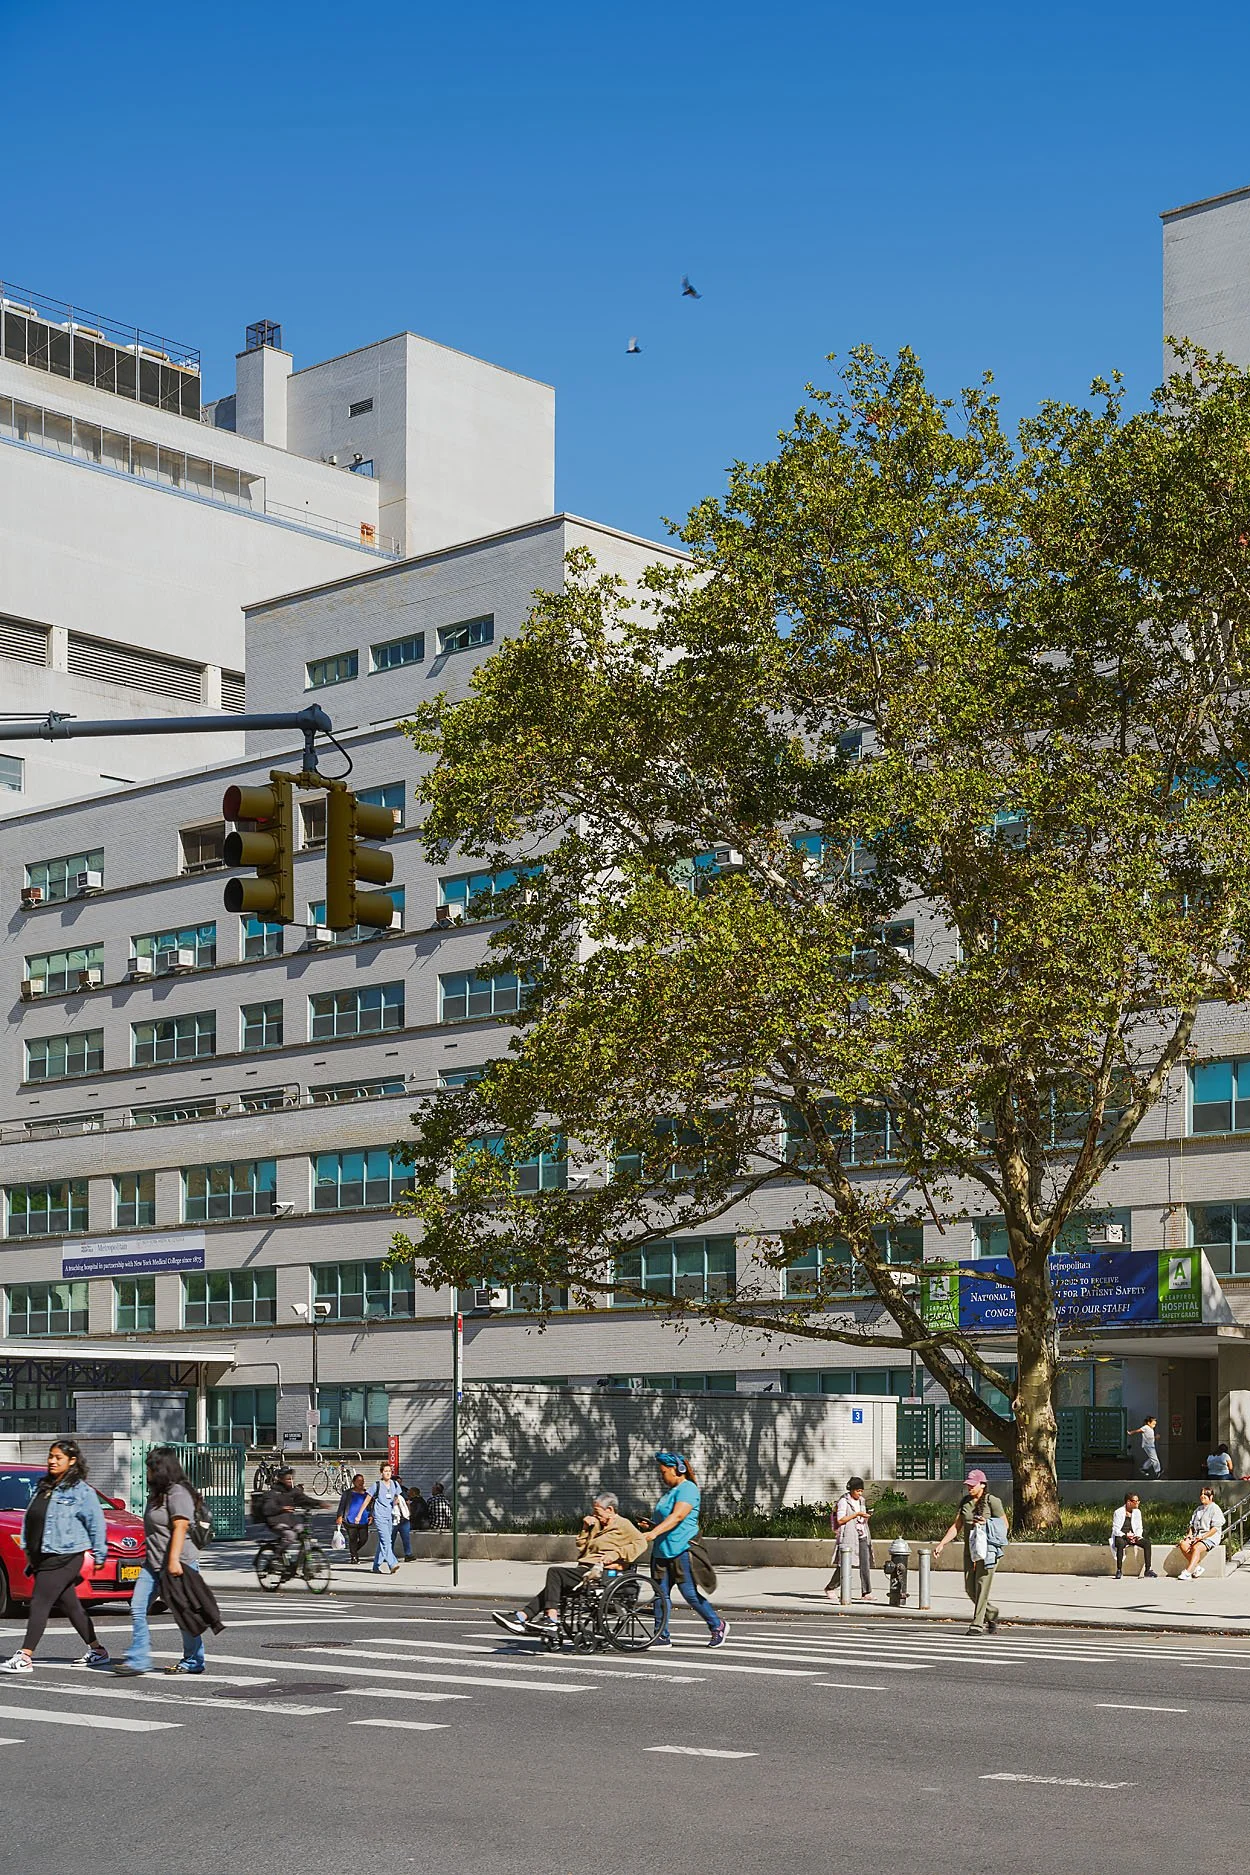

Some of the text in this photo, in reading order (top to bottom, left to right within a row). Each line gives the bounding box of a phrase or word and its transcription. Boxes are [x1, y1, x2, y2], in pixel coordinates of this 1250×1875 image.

[1049, 1262, 1091, 1272] etropolitan
[1174, 1261, 1186, 1280] A
[1069, 1306, 1080, 1314] TO
[1082, 1305, 1100, 1313] OUR
[1102, 1304, 1131, 1313] STAFF!
[1161, 1302, 1199, 1311] HOSPITAL
[855, 1412, 860, 1421] 3
